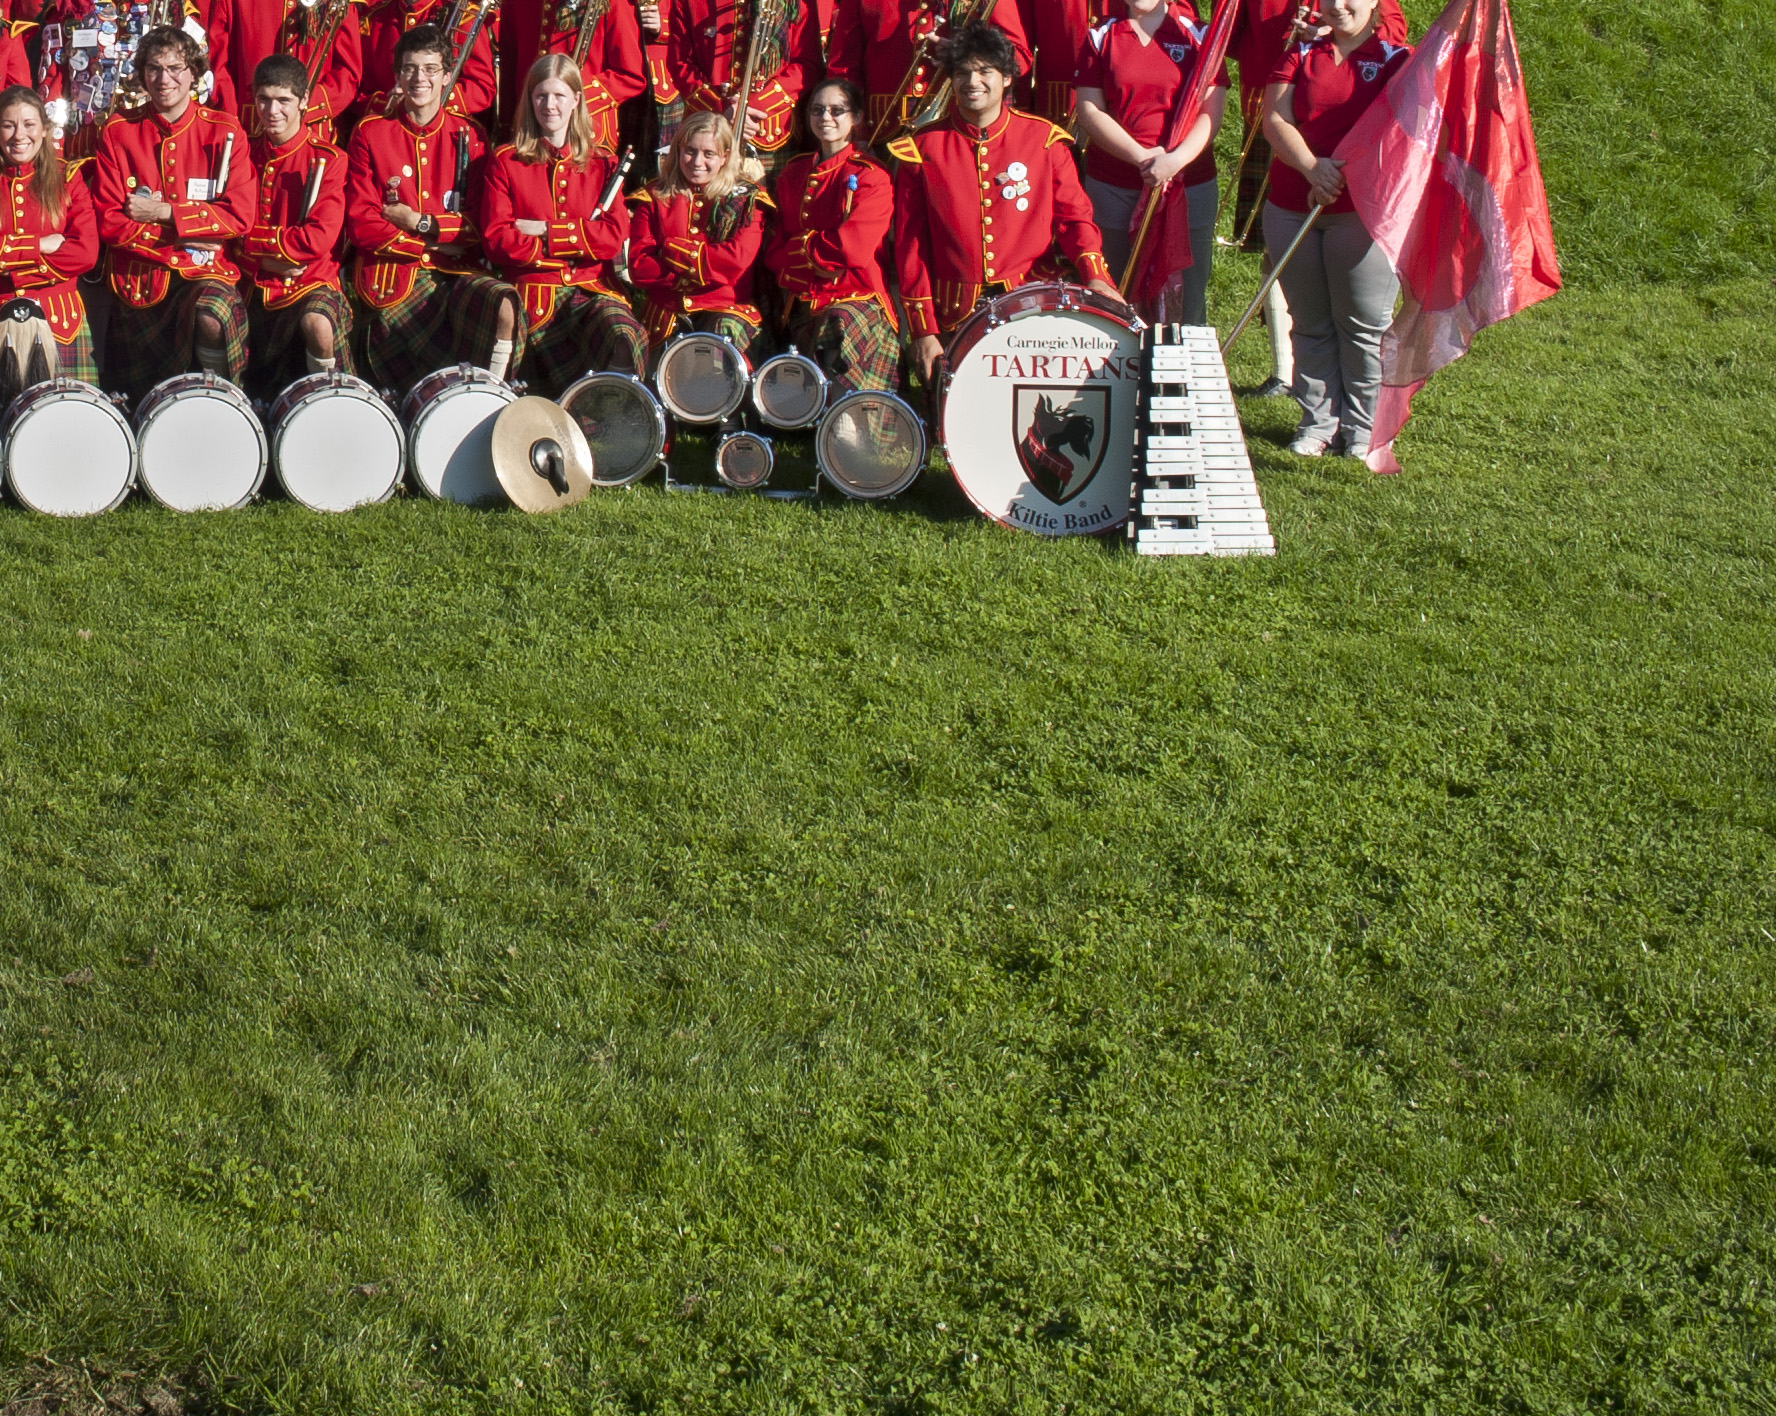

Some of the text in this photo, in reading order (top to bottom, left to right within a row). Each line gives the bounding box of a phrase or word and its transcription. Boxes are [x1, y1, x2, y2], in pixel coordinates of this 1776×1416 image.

[1007, 335, 1119, 353] Carnegie Mellon
[982, 354, 1140, 381] TARTANS
[1008, 502, 1113, 530] Kiltie Band
